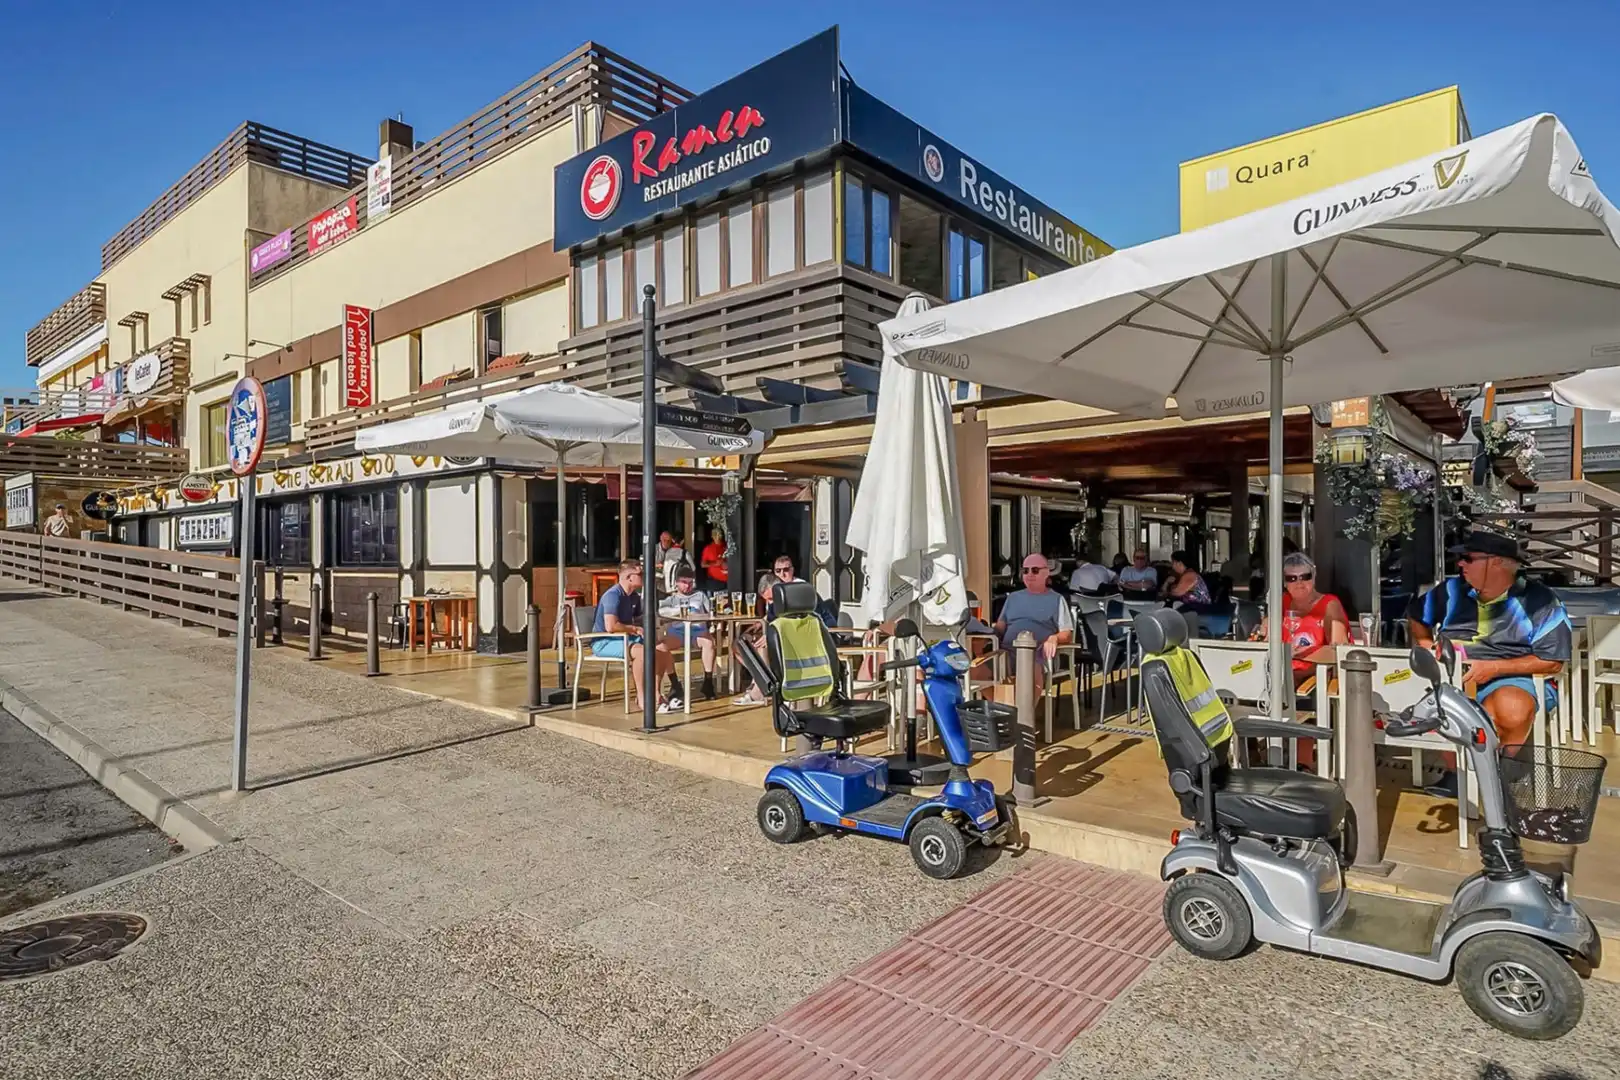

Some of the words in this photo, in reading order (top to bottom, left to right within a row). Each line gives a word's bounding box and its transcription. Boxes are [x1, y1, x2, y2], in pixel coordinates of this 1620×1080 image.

[632, 105, 764, 184] Ramen
[644, 161, 716, 203] RESTAURANTE
[716, 136, 771, 174] ASIÁTICO
[1235, 154, 1309, 184] Quara
[960, 157, 1097, 265] Restaurante
[1293, 174, 1422, 236] GUINNESS
[347, 327, 356, 348] and
[358, 328, 370, 387] papapizza
[347, 351, 357, 387] kebab
[707, 434, 744, 448] GUINNESS
